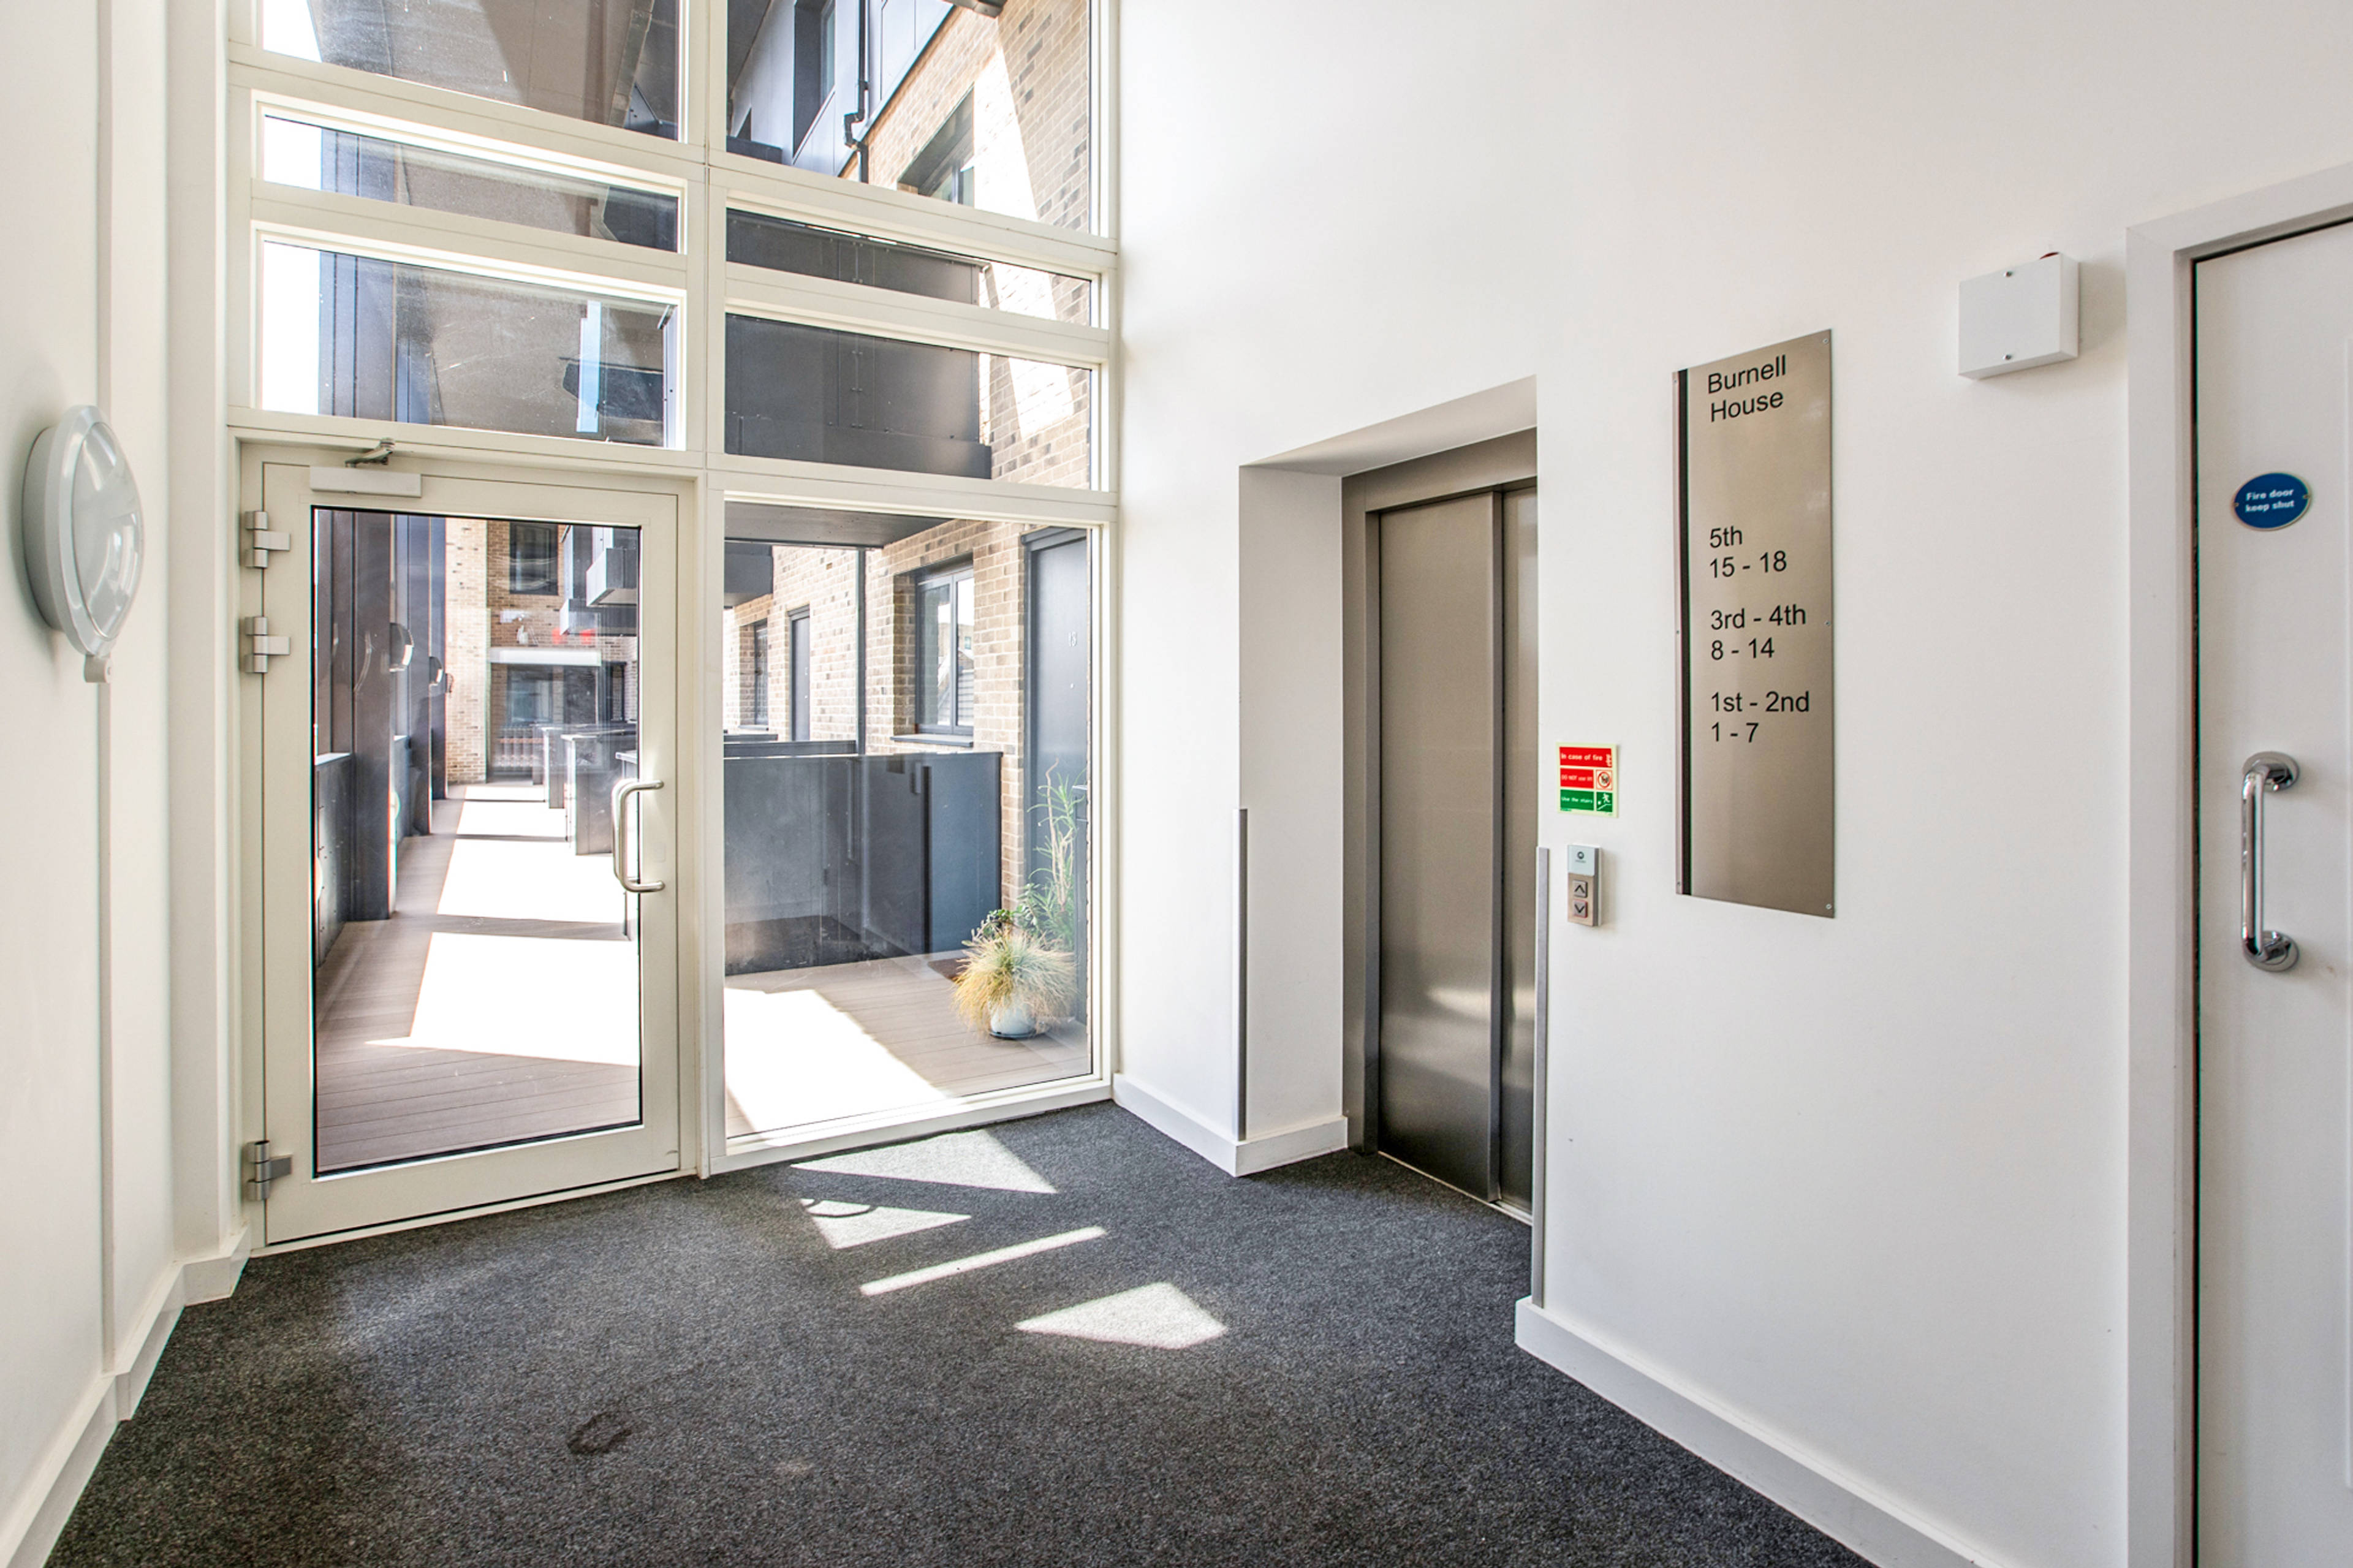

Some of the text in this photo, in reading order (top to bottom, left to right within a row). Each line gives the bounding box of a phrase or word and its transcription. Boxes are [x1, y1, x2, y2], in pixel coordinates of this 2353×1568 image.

[1708, 354, 1786, 394] Burnell
[1711, 391, 1783, 422] House
[2245, 500, 2295, 513] keep shut
[2246, 489, 2294, 501] Fire door
[1710, 525, 1743, 548] 5th
[1710, 556, 1735, 578] 15
[1760, 550, 1787, 573] 18
[1711, 608, 1745, 631] 3rd
[1768, 604, 1806, 626] 4th
[1711, 639, 1724, 661] 8
[1748, 637, 1775, 659] 14
[1711, 691, 1743, 712] 1st
[1765, 690, 1809, 713] 2nd
[1711, 722, 1719, 742] 1
[1746, 722, 1759, 743] 7
